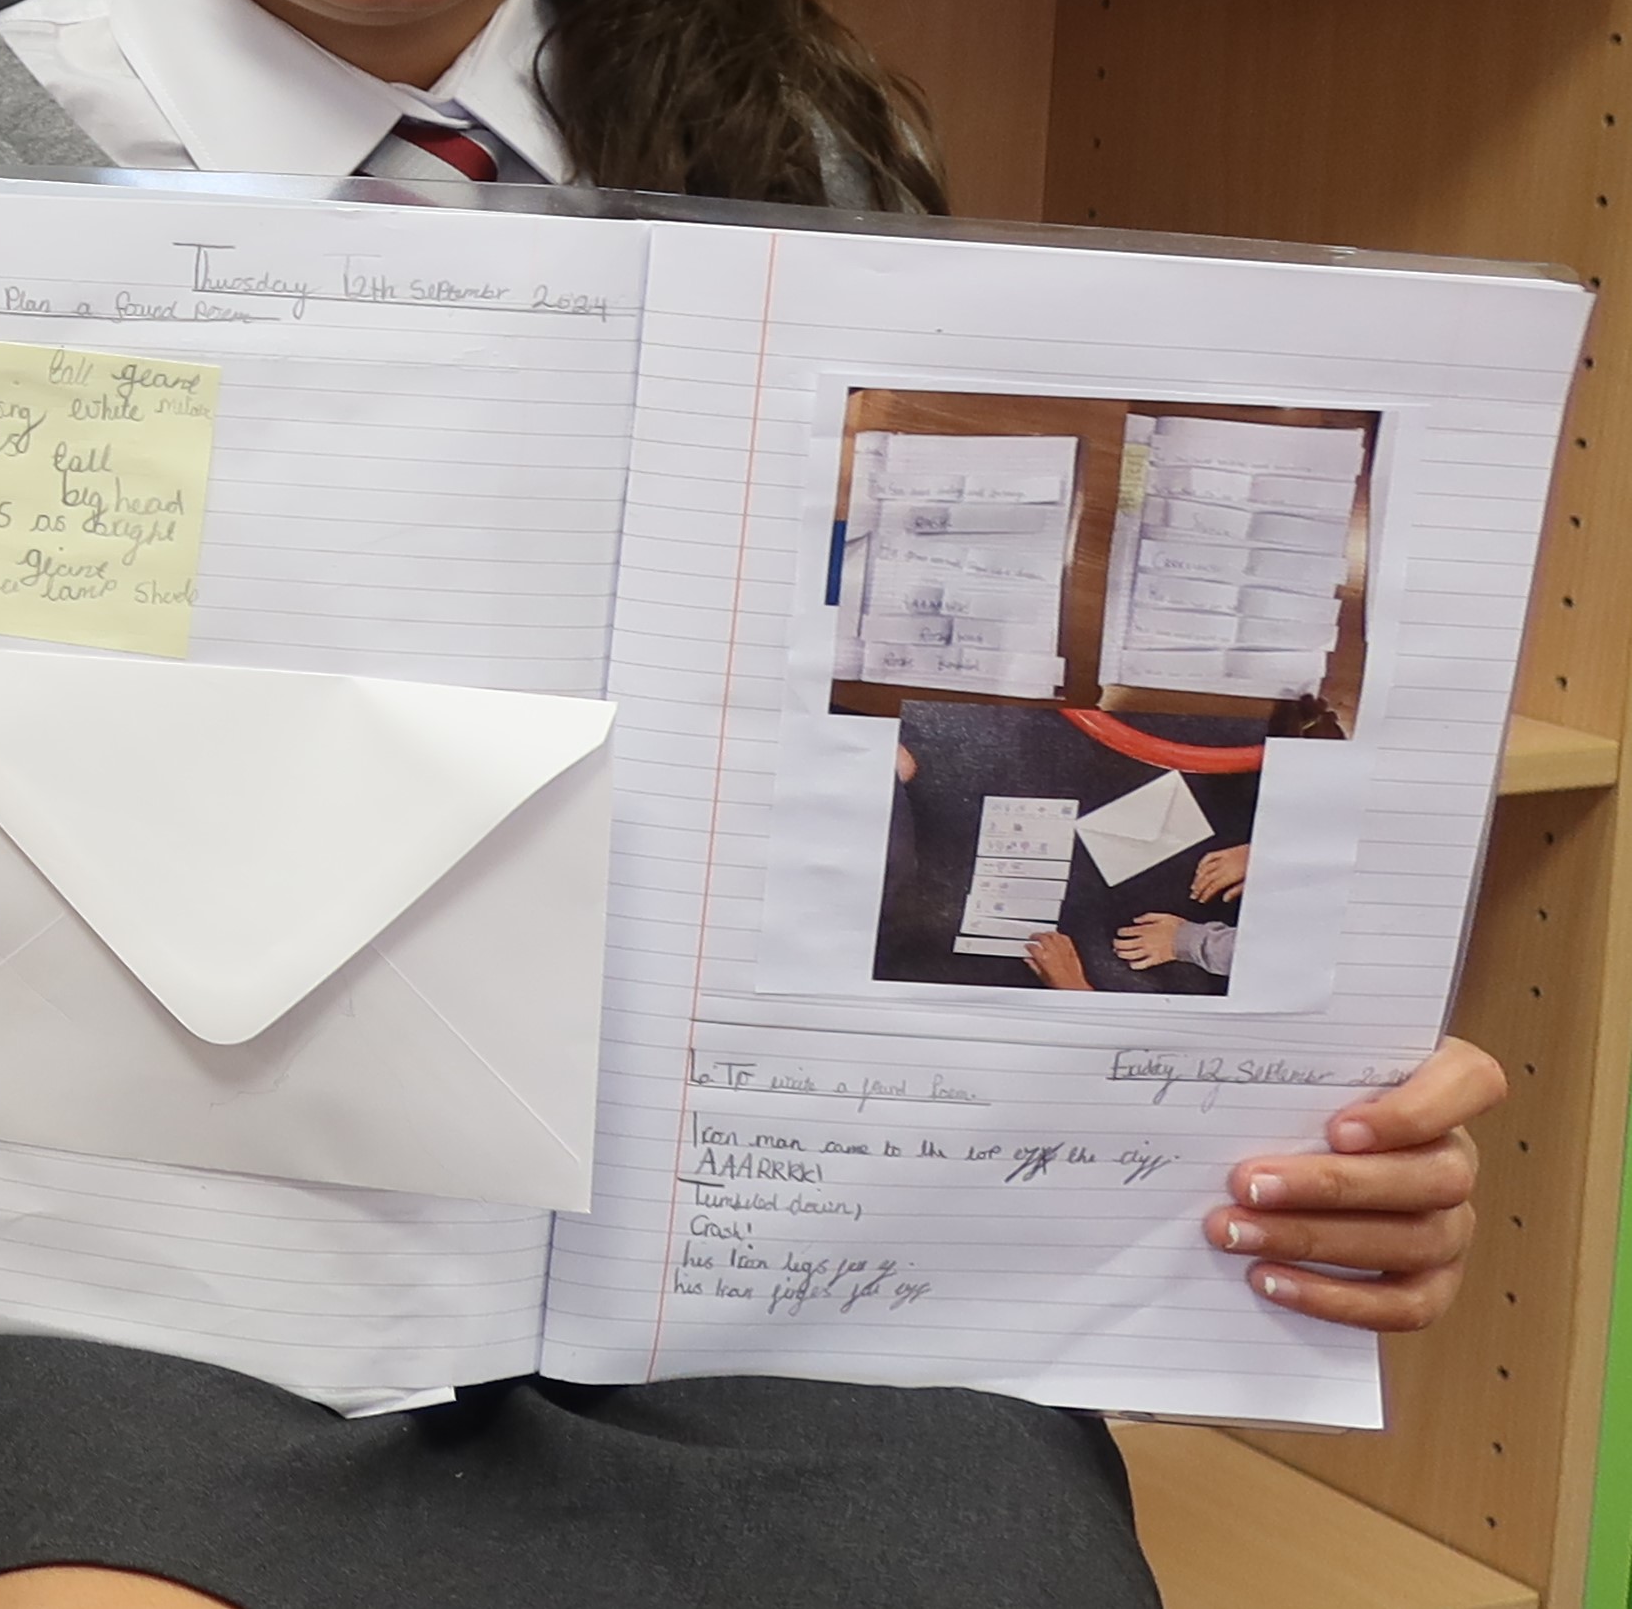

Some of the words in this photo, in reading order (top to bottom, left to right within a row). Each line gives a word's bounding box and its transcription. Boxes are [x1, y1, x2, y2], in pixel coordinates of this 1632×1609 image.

[76, 300, 94, 317] a
[531, 283, 610, 323] 2024
[114, 475, 186, 517] head
[28, 513, 67, 534] as
[691, 1110, 739, 1148] Iron
[749, 1133, 805, 1152] man
